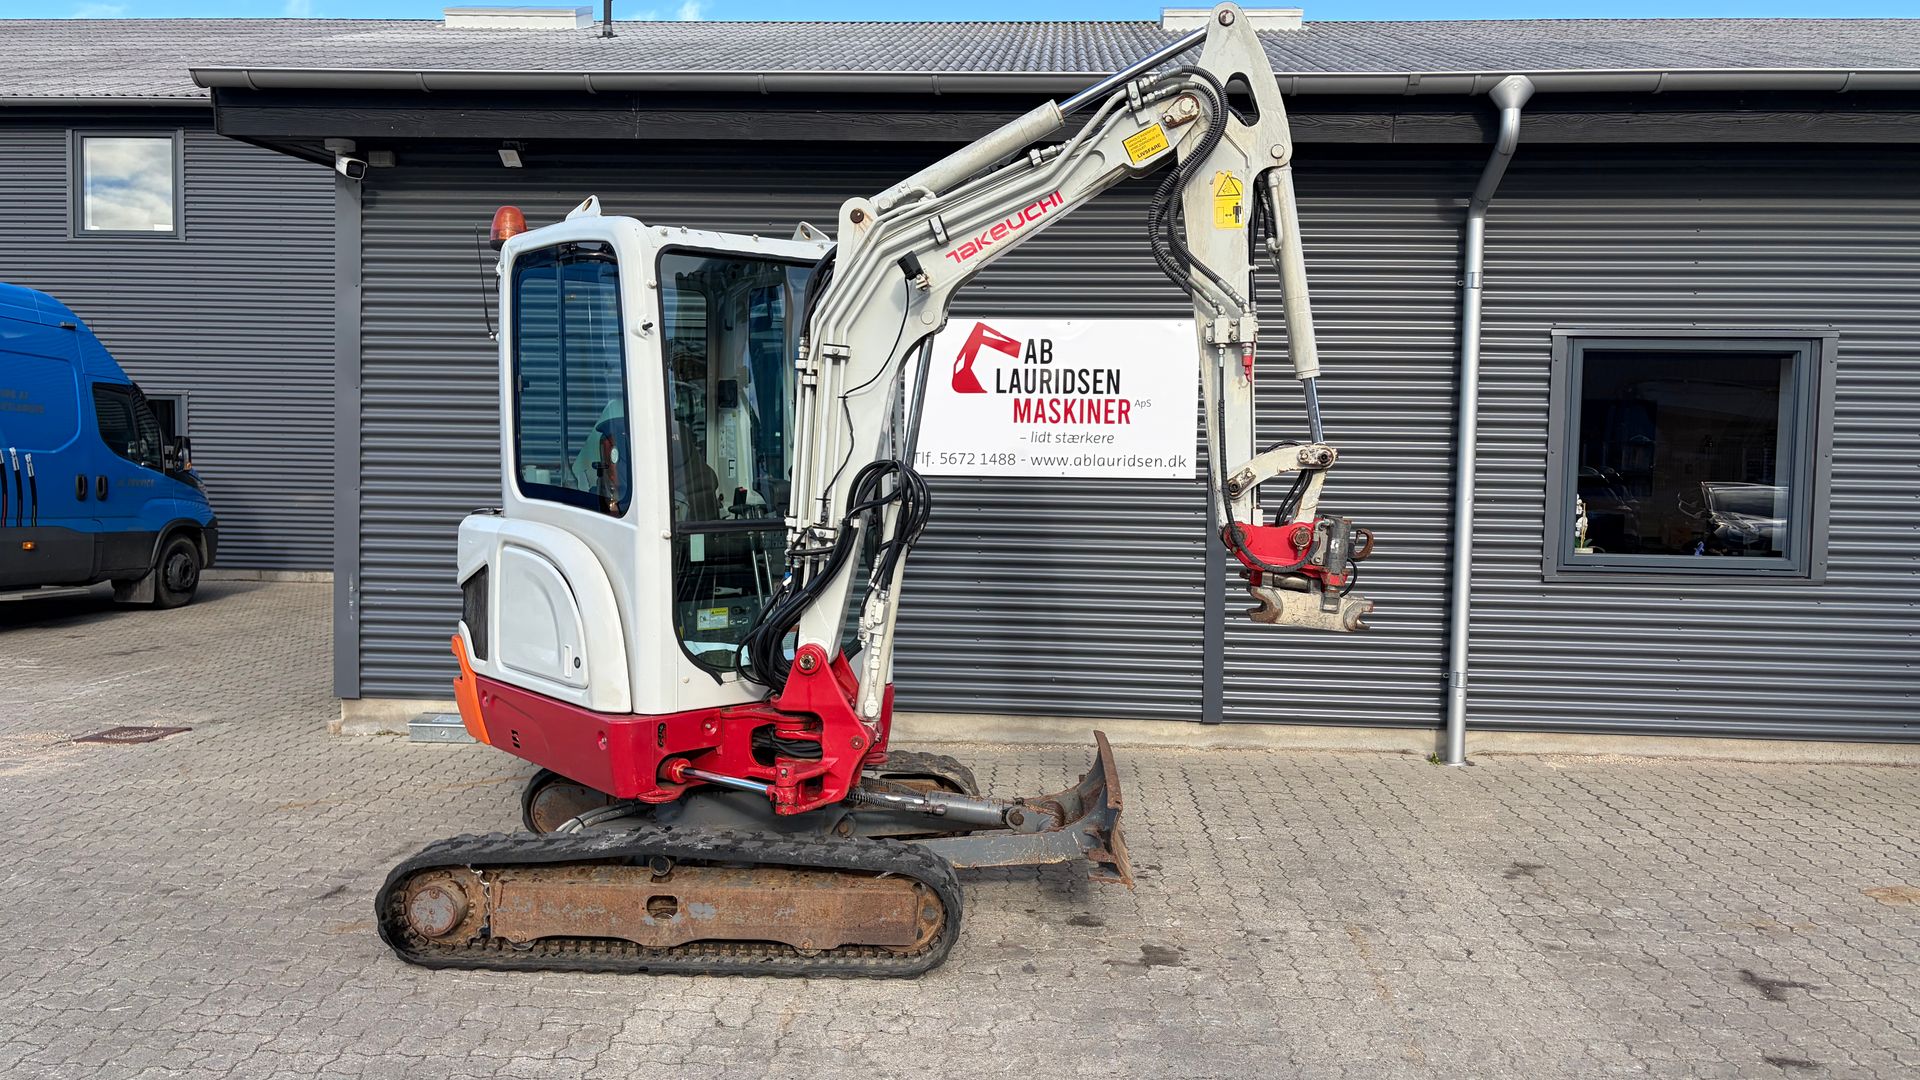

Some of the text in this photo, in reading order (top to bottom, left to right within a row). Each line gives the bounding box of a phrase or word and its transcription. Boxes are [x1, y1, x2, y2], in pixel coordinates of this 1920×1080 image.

[1137, 143, 1162, 158] LIVSFARE
[1024, 338, 1053, 364] AB
[996, 368, 1121, 395] LAURIDSEN
[1013, 398, 1152, 425] MASKINER ApS
[1030, 431, 1052, 444] lidt
[1055, 432, 1115, 444] stærkere
[915, 451, 935, 467] Tlf.
[939, 452, 976, 465] 5672
[980, 453, 1016, 466] 1488
[1030, 453, 1187, 468] www.ablauridsen.dk
